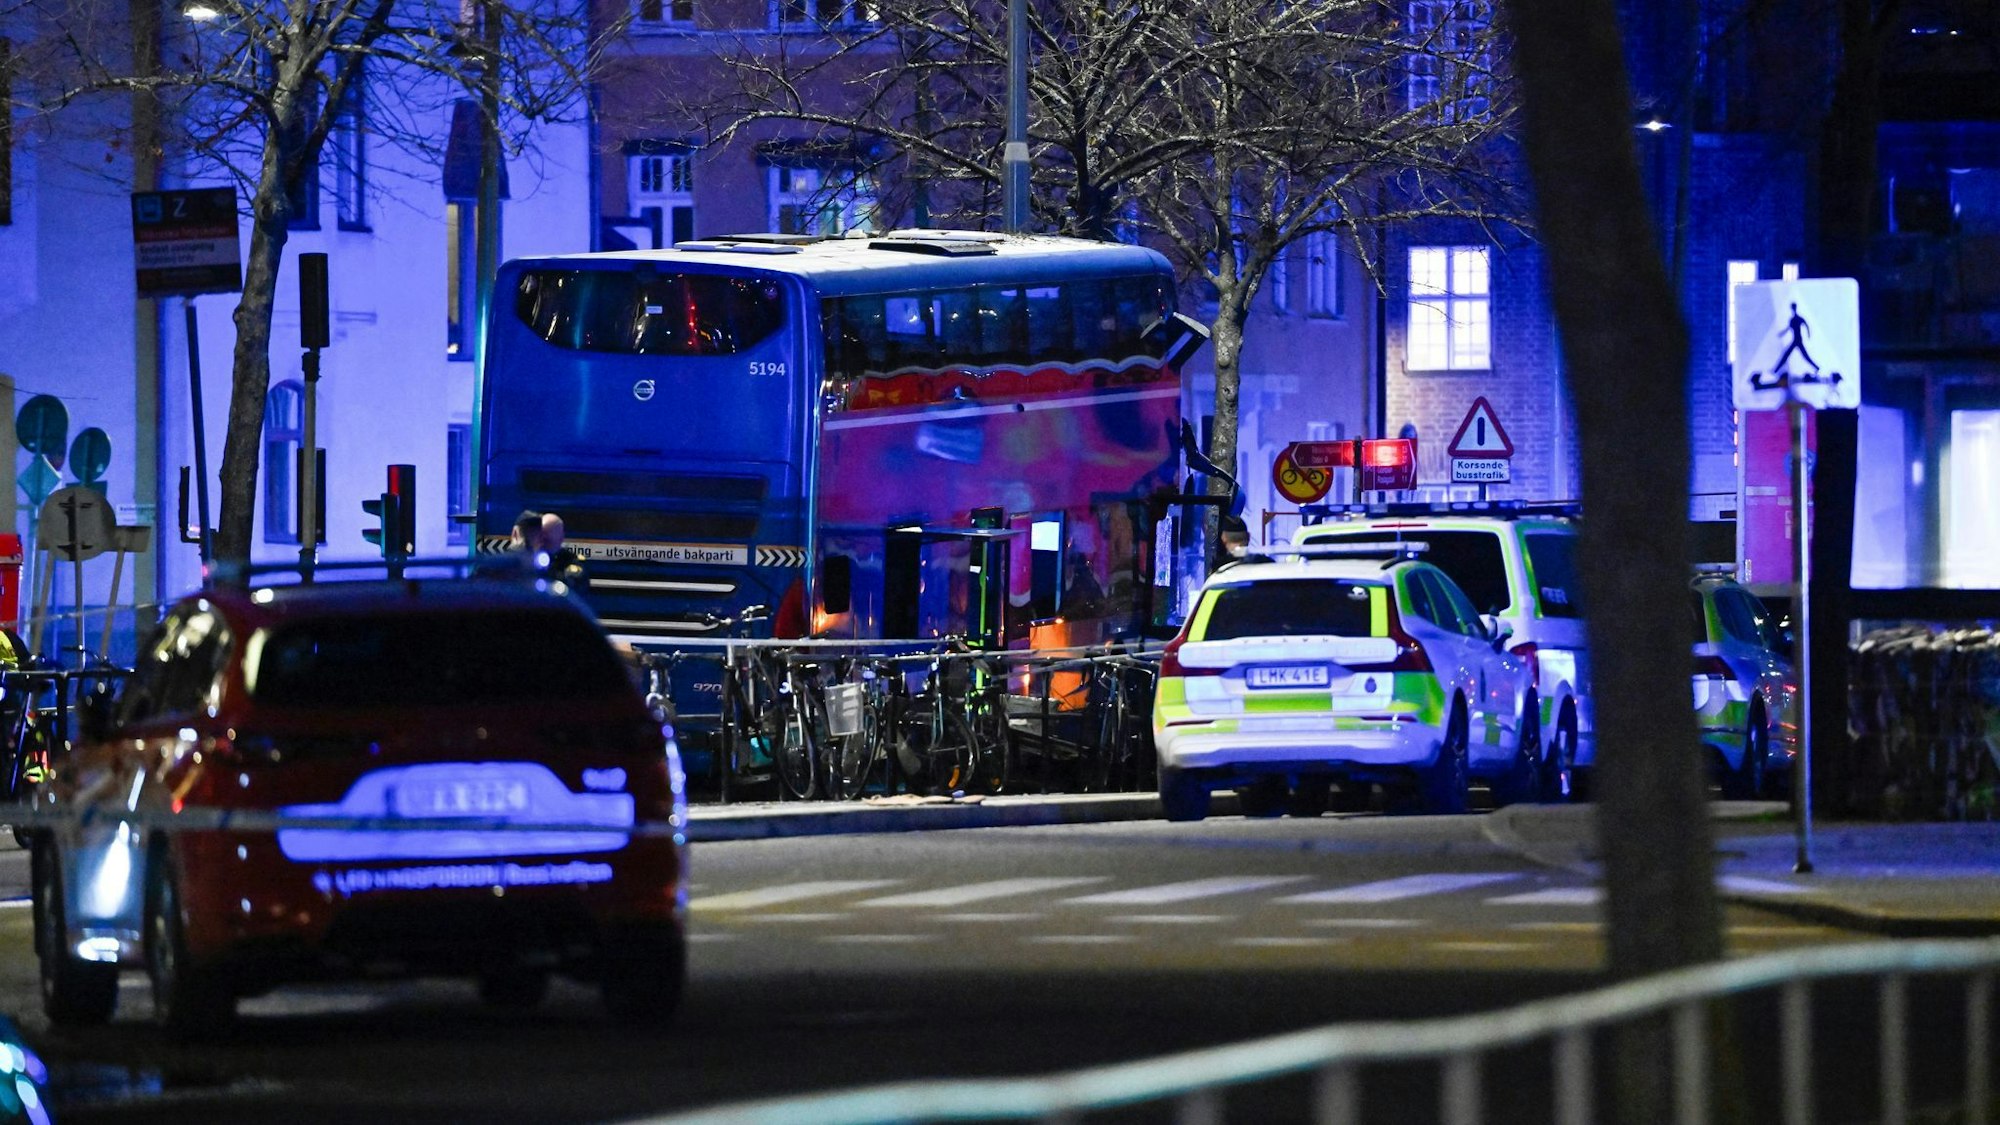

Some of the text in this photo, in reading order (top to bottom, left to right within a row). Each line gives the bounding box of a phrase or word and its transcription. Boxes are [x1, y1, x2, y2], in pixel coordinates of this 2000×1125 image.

[172, 197, 188, 218] Z
[749, 361, 786, 376] 5194
[1457, 461, 1503, 469] Korsande
[1456, 471, 1504, 479] busstrafik
[606, 546, 680, 560] utsvängande
[684, 547, 734, 562] bakparti
[1292, 668, 1320, 682] 41E
[693, 683, 722, 692] 970
